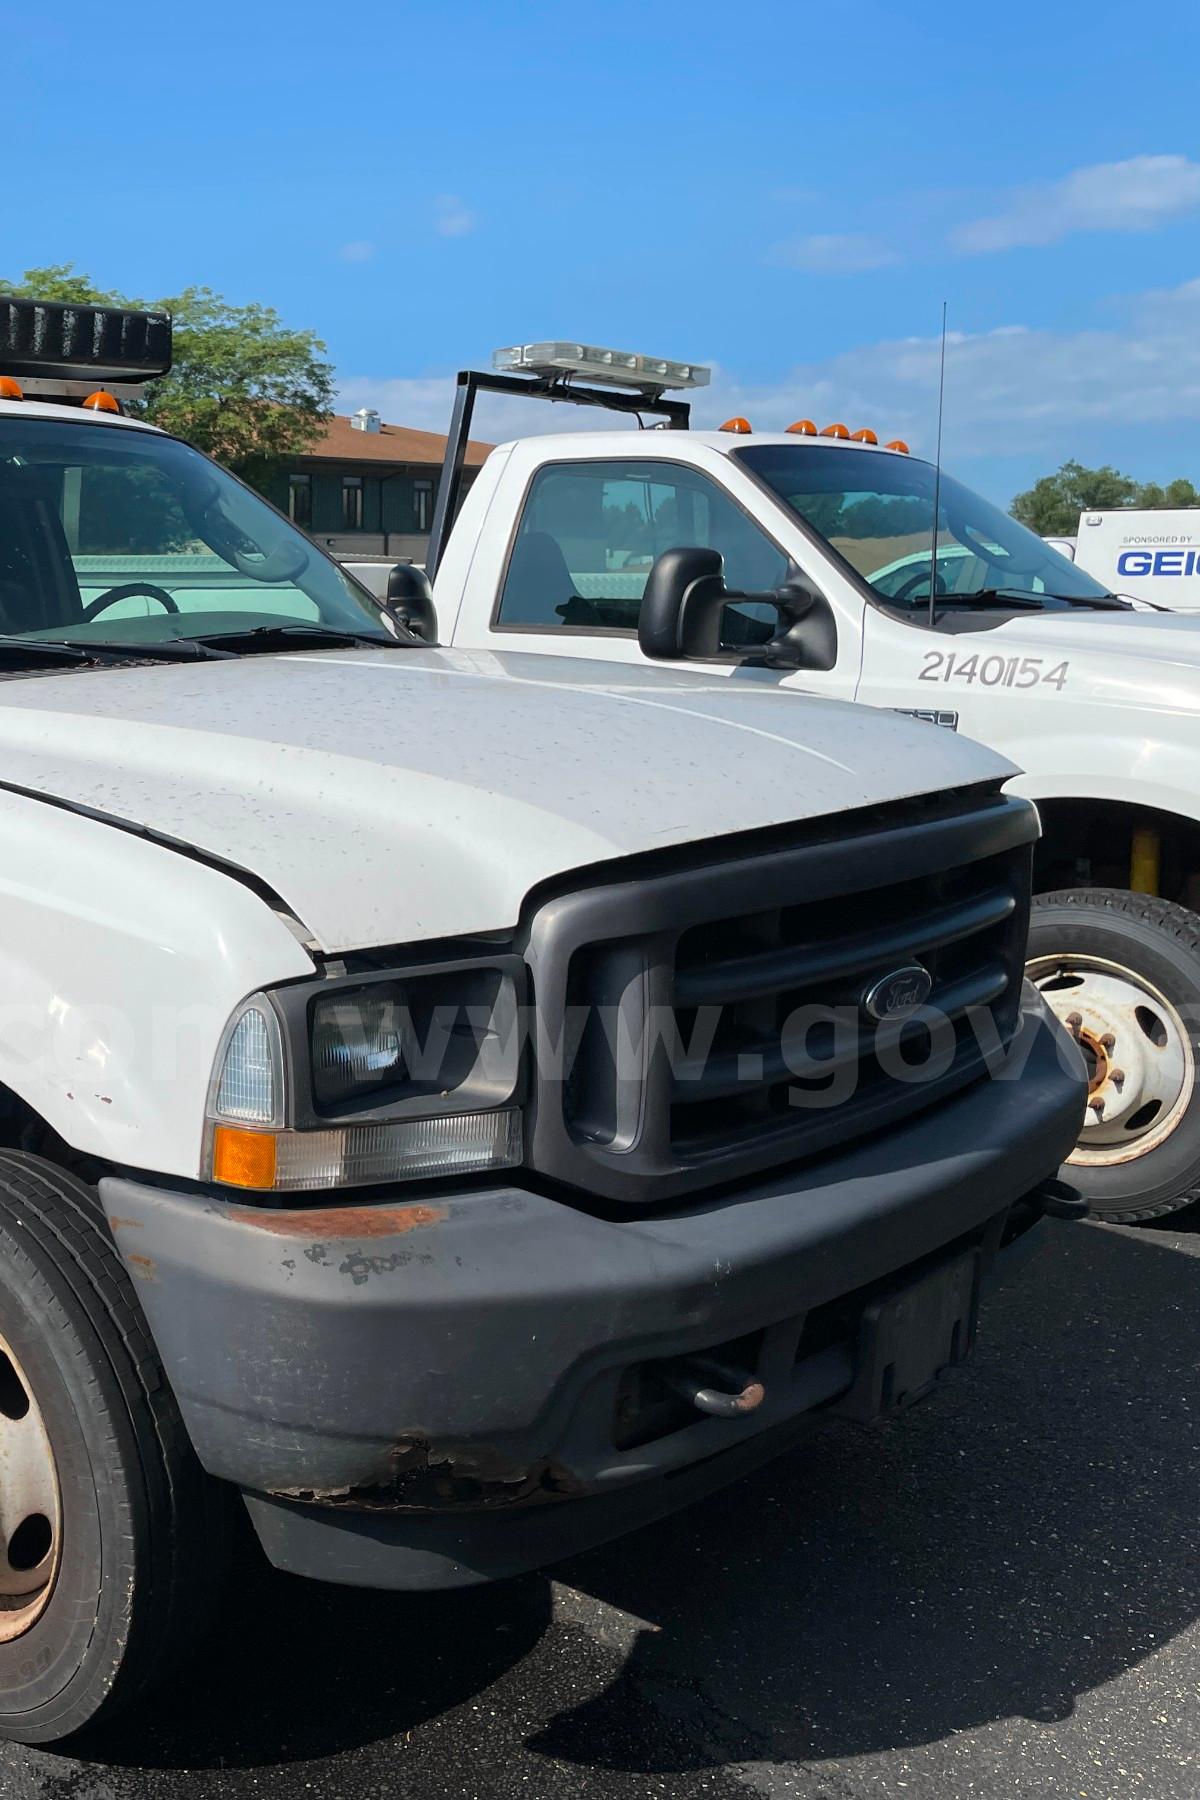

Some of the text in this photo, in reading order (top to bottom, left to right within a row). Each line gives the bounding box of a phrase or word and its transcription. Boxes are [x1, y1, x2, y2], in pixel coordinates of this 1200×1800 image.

[1122, 535, 1194, 544] SPONSORED BY
[1117, 551, 1200, 577] GEI
[917, 651, 1070, 691] 2140154
[886, 977, 921, 1012] Ford
